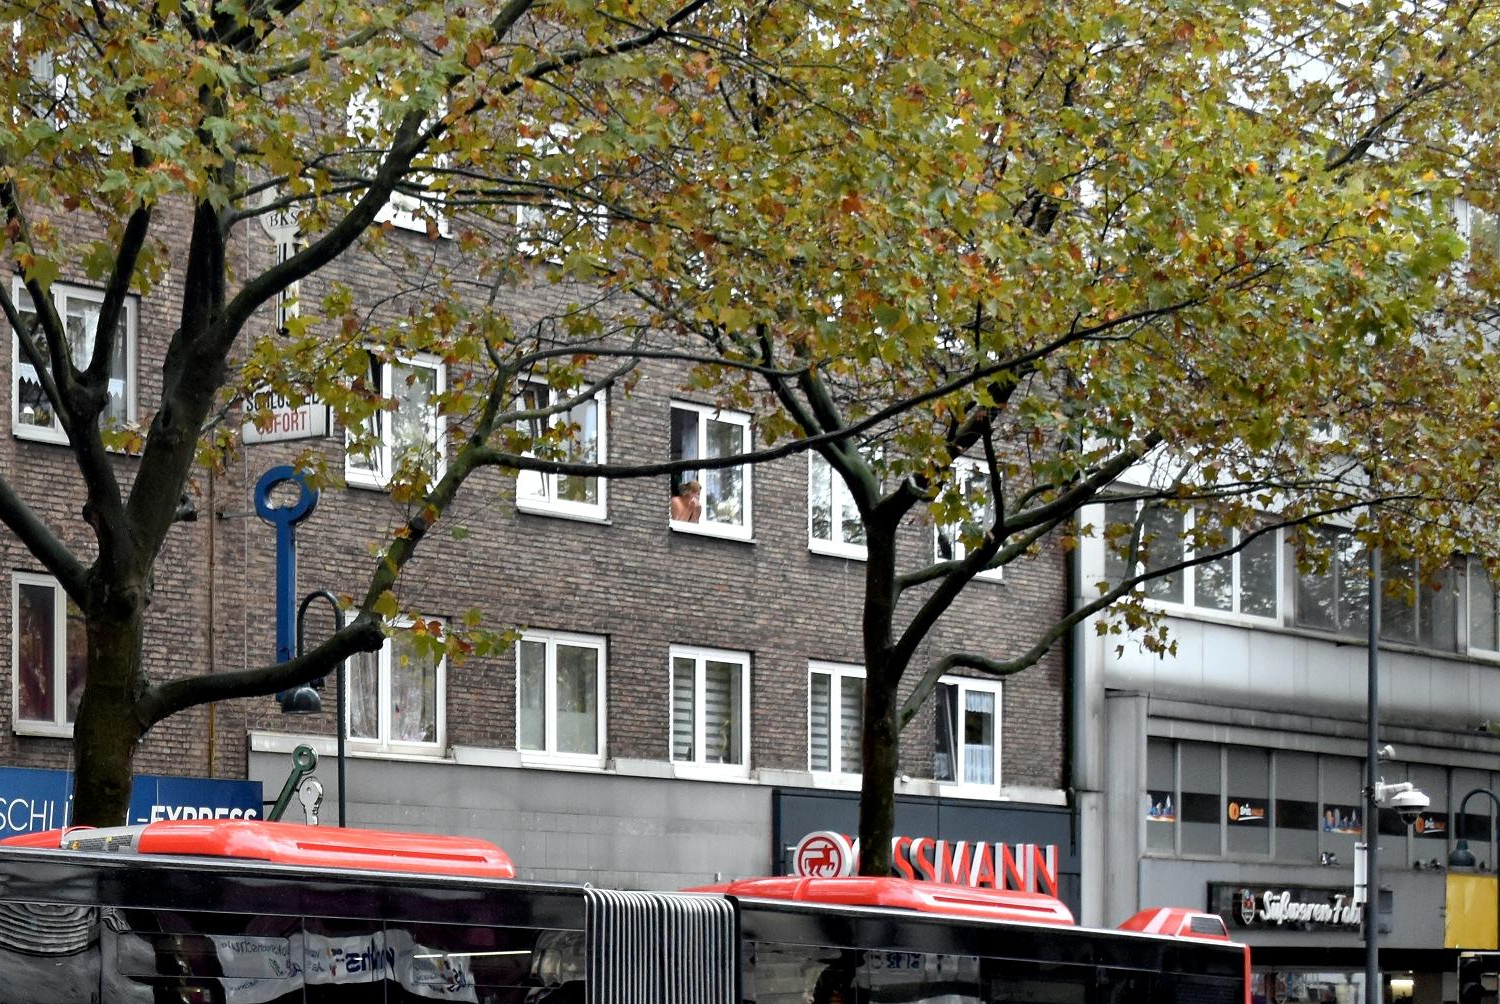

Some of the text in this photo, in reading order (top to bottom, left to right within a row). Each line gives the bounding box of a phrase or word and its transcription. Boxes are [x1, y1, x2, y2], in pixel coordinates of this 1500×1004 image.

[270, 212, 298, 226] BKS
[256, 410, 307, 435] FORT
[843, 833, 1058, 898] SSMANN
